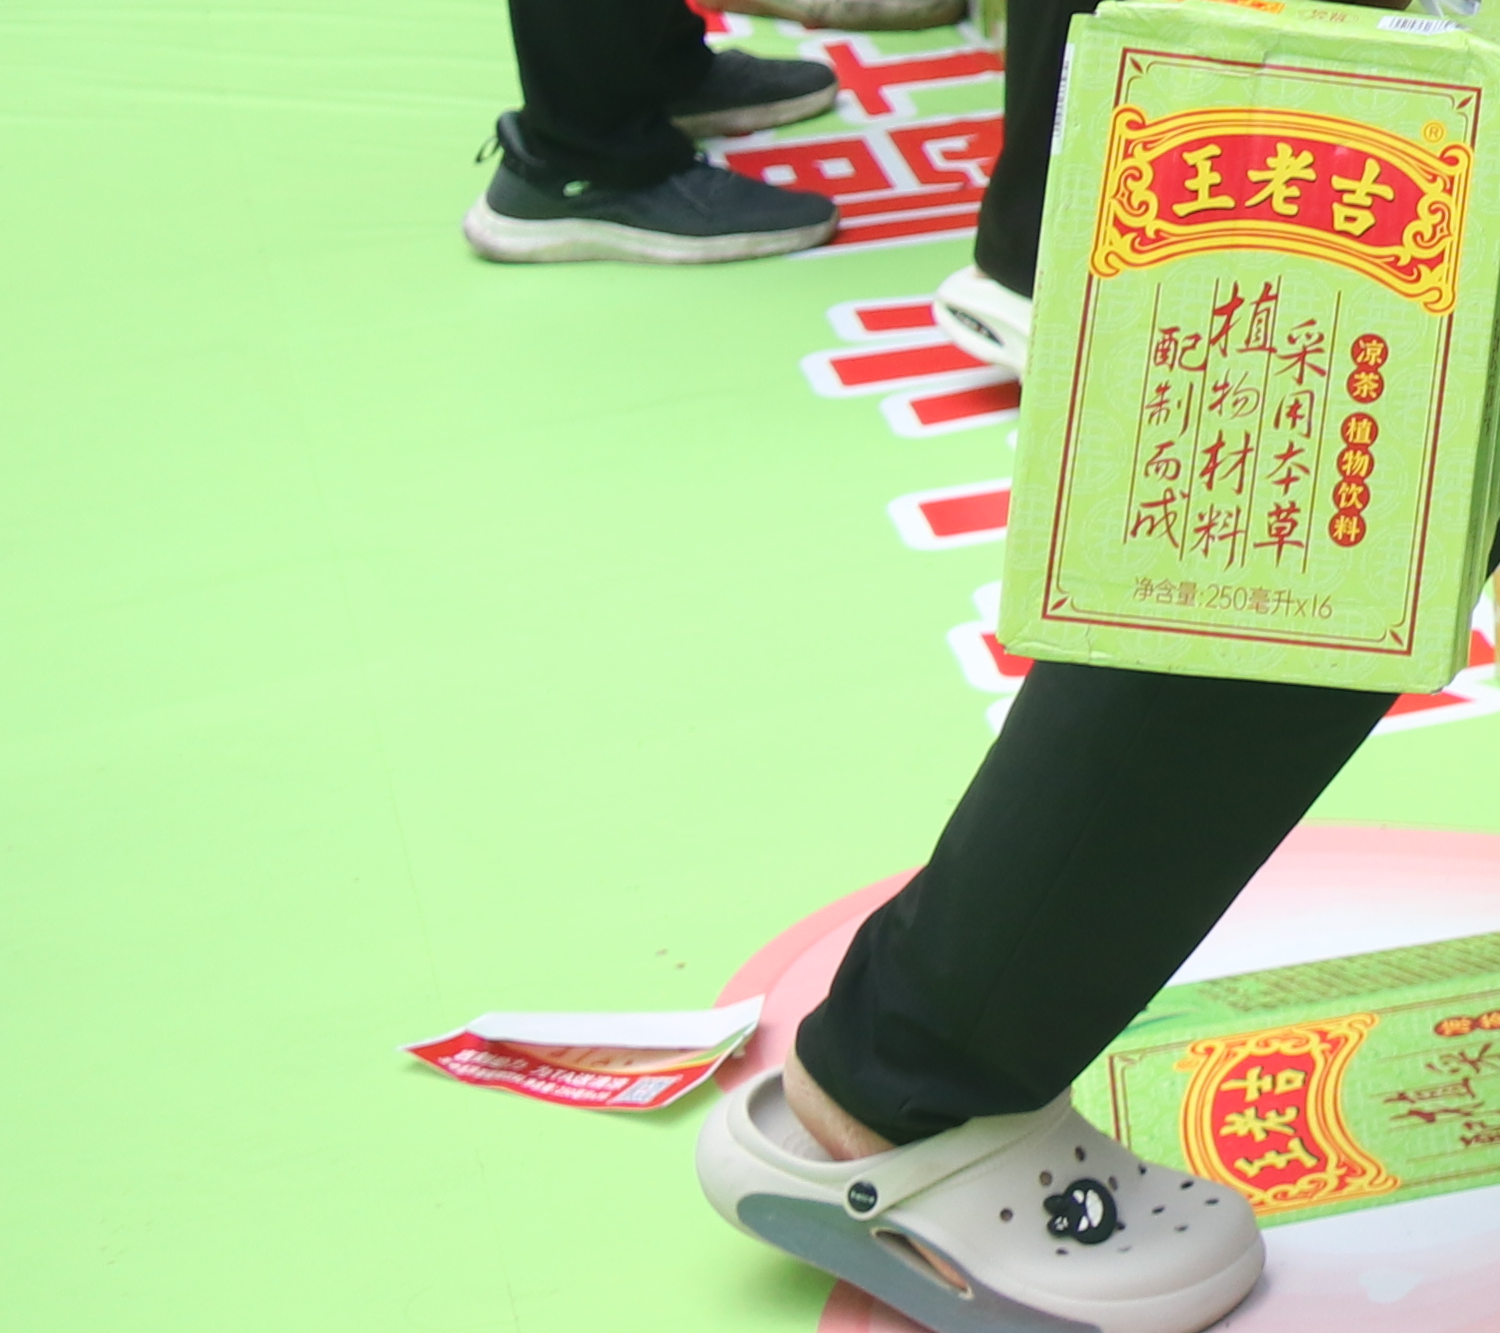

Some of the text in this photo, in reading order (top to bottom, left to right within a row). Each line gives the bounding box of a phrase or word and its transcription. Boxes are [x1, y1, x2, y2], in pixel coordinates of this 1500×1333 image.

[1171, 142, 1395, 238] 王老吉
[1189, 275, 1280, 570] 植物材料
[1351, 337, 1386, 401] 凉茶
[1130, 325, 1208, 548] 配制而成
[1252, 319, 1329, 568] 采用本草
[1332, 415, 1375, 545] 植物饮料
[1131, 576, 1334, 621] 净含量:250毫升x16
[1218, 1064, 1318, 1183] 王老吉
